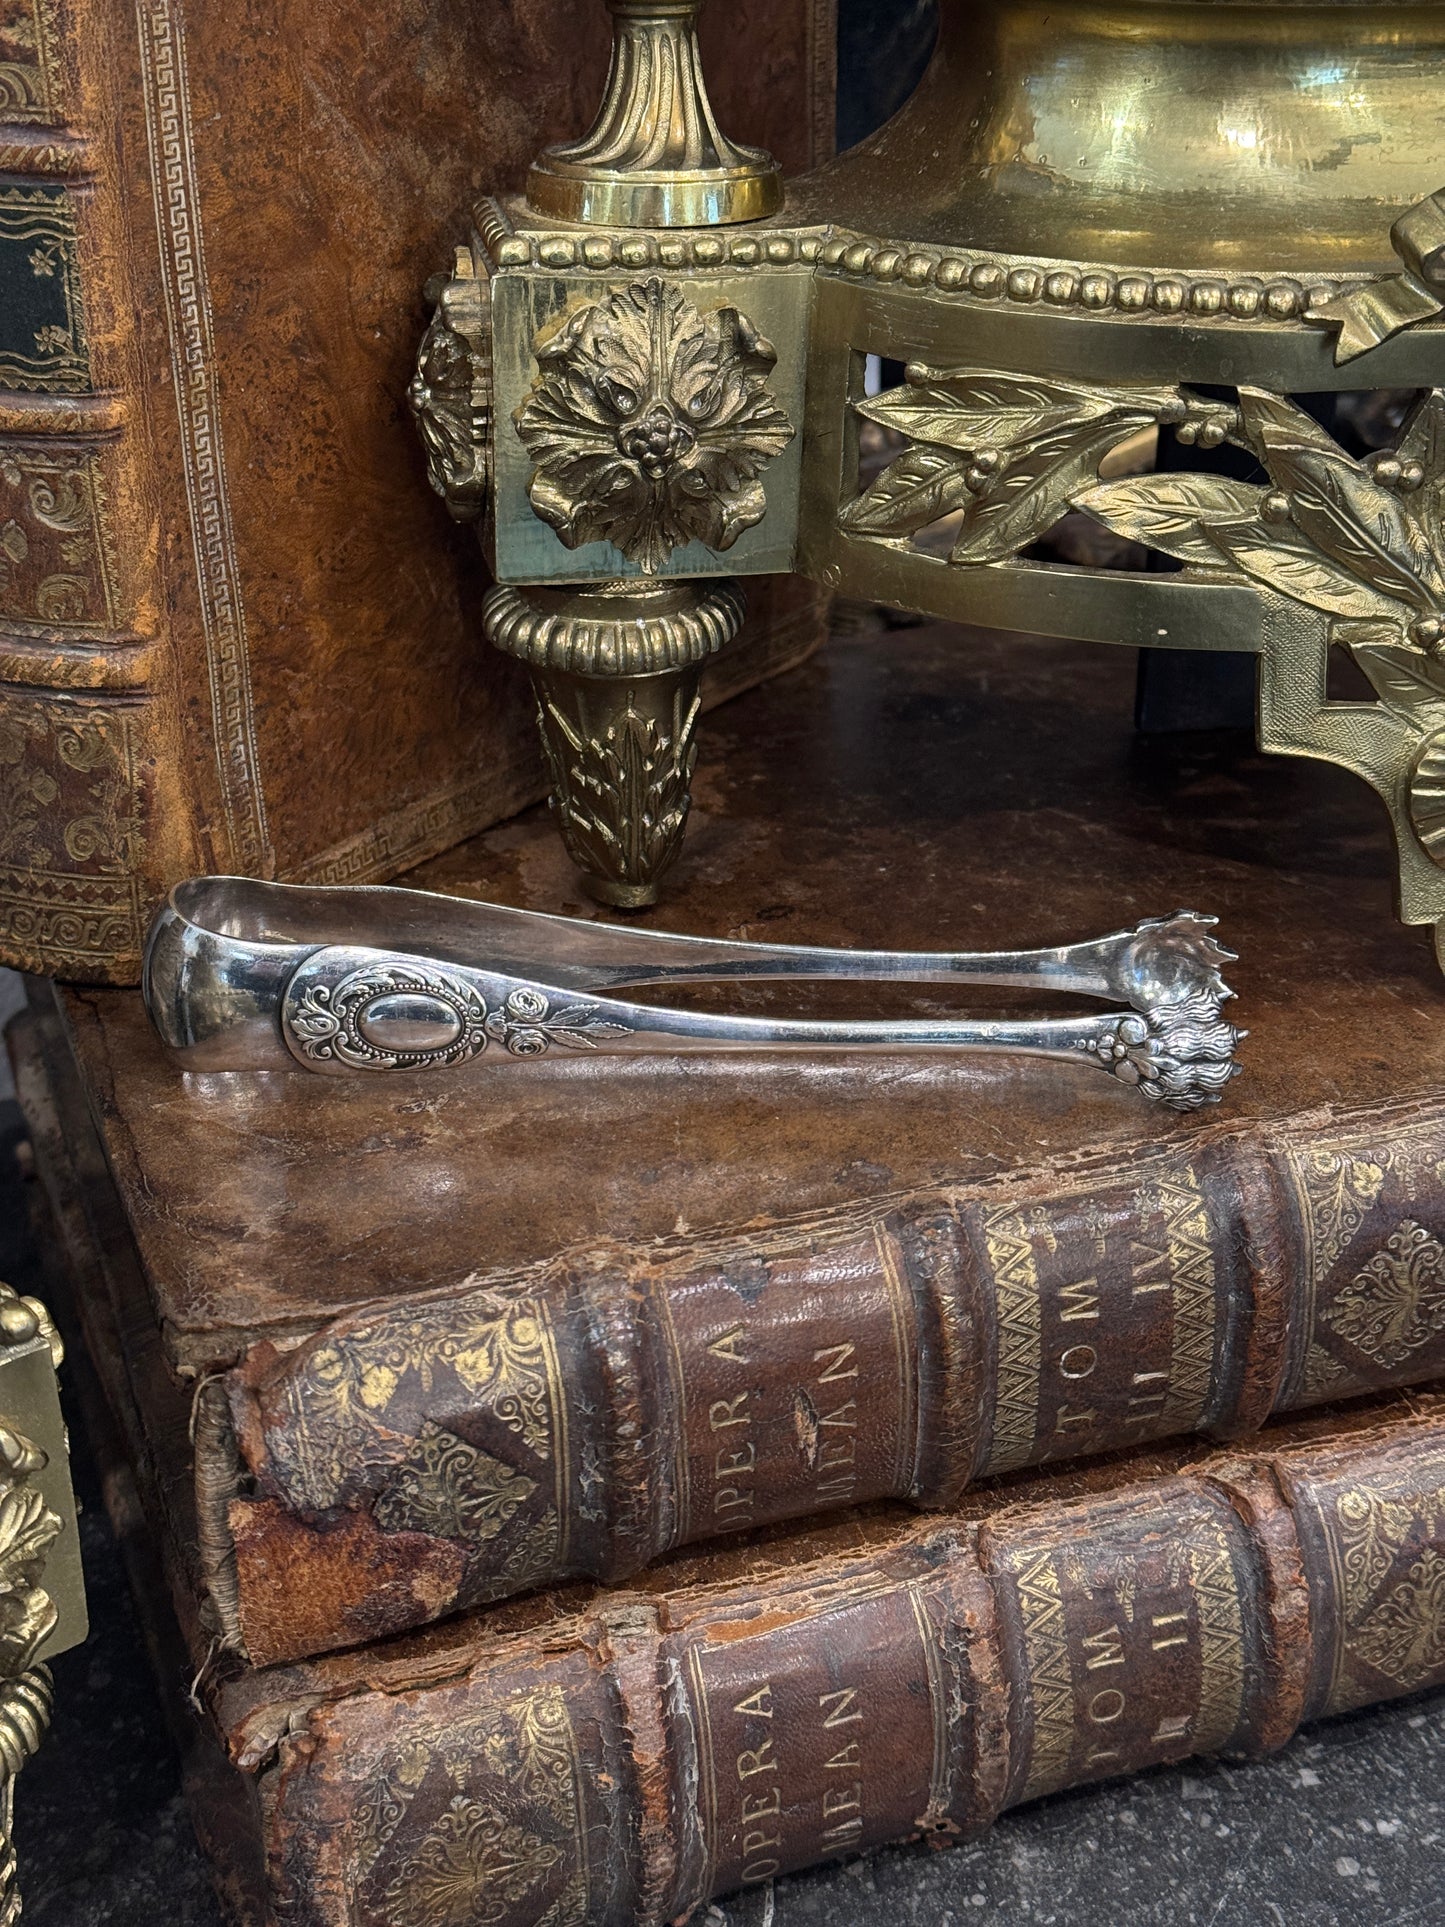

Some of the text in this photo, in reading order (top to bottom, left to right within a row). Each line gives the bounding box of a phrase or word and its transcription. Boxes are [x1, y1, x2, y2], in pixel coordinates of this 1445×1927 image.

[1130, 1240, 1171, 1296] IV
[706, 1322, 754, 1534] OPERA
[813, 1340, 859, 1503] MEAN
[1055, 1275, 1100, 1434] TOM
[1081, 1623, 1126, 1769] TOM
[1151, 1608, 1189, 1651] II
[733, 1683, 783, 1881] OPERA
[818, 1686, 864, 1852] MEAN
